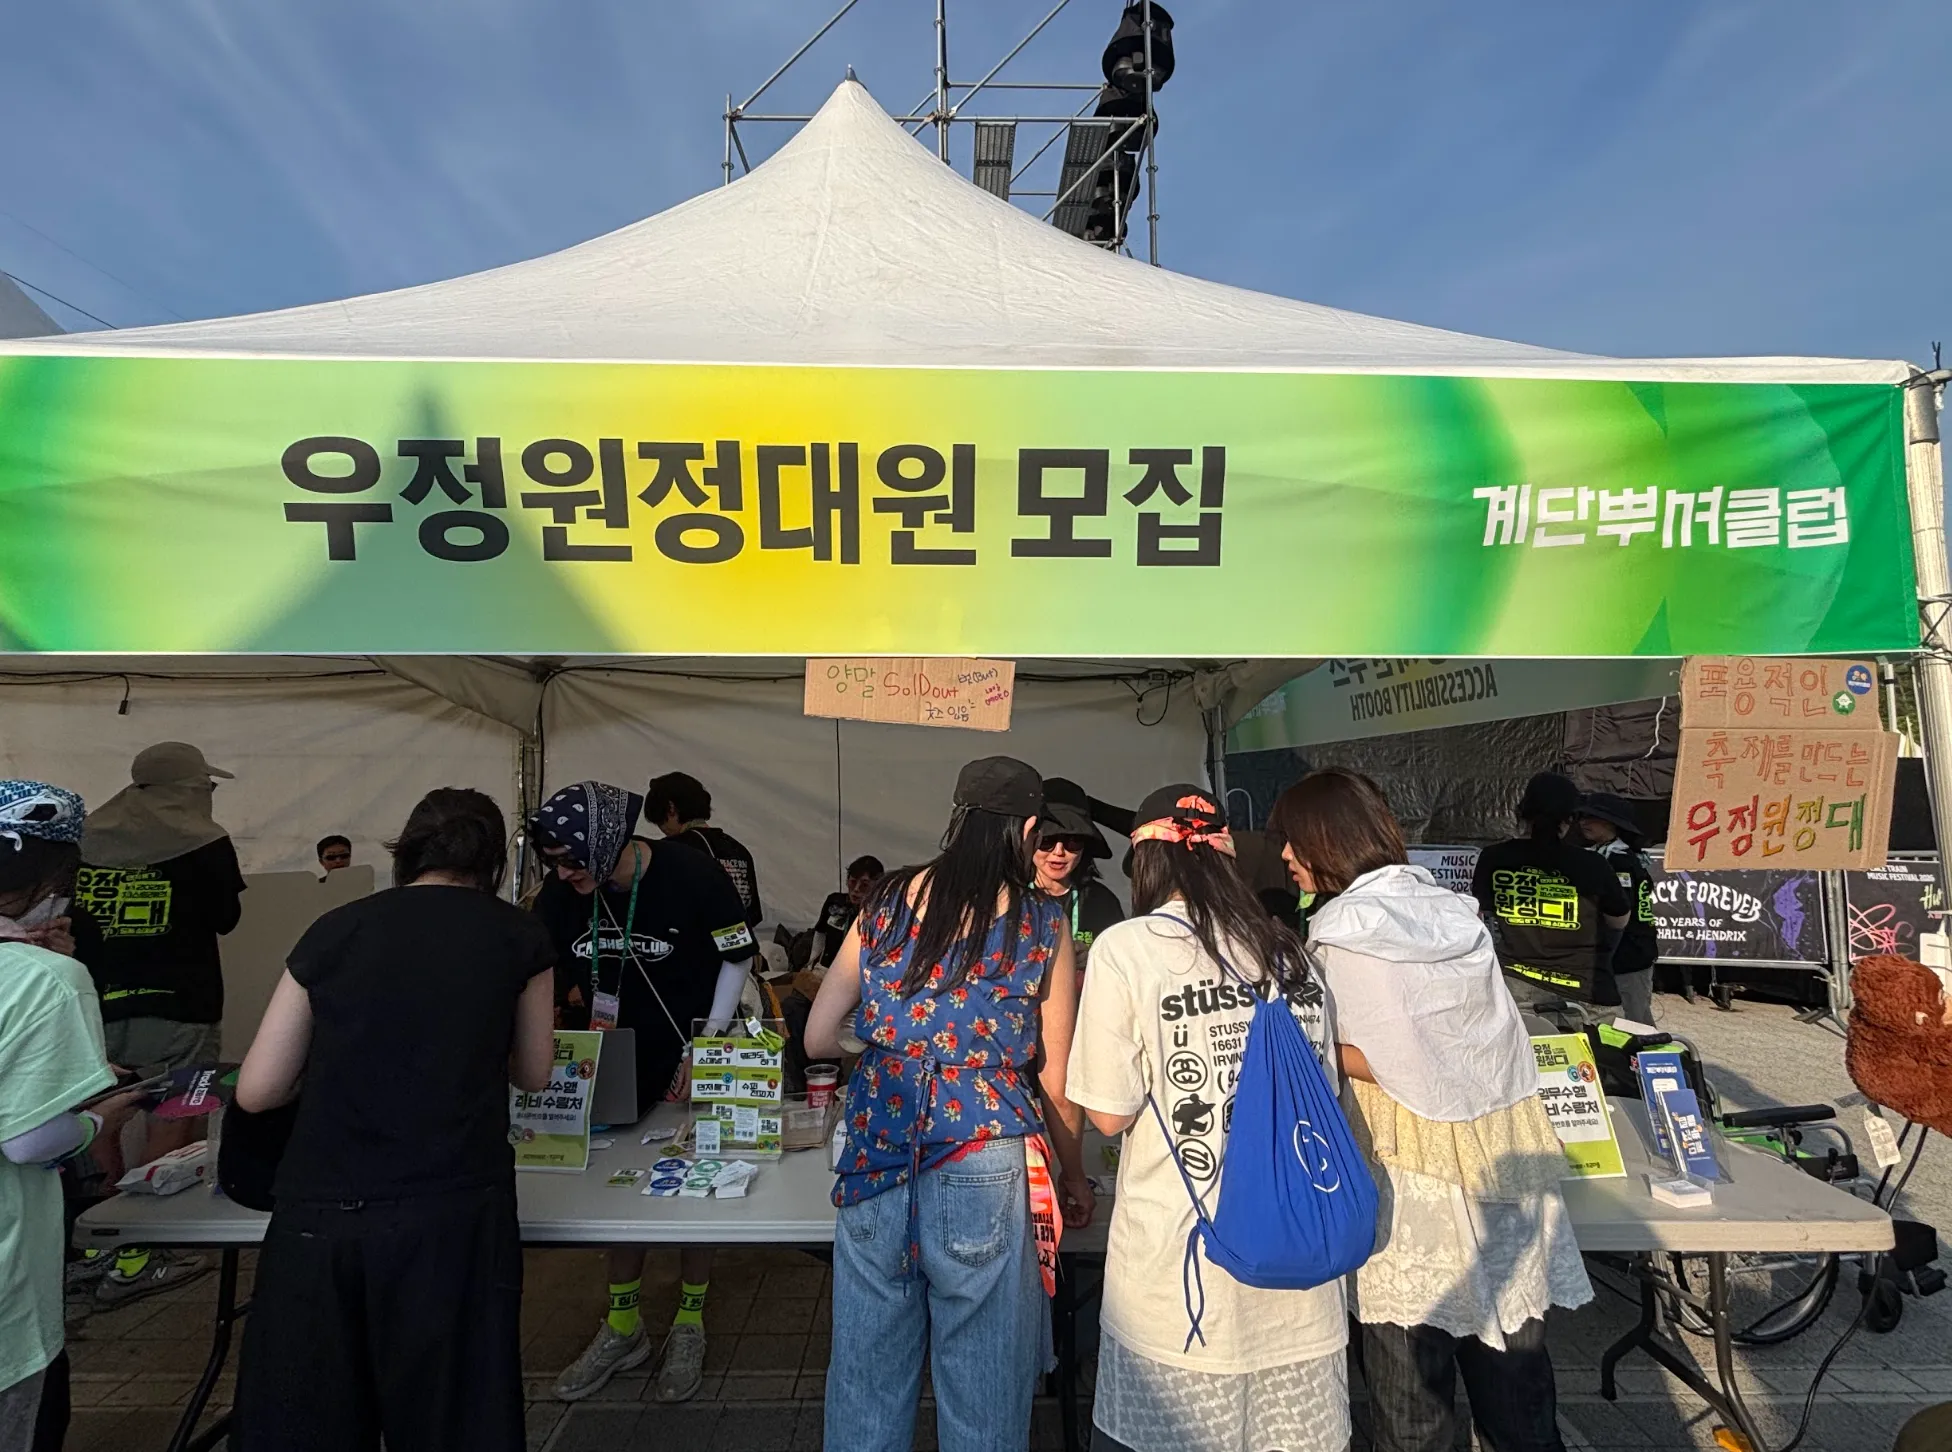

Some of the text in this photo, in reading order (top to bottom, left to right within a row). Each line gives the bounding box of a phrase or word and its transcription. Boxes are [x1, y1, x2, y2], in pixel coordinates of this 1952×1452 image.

[281, 435, 1227, 567] 우정원정대원 모집
[1472, 484, 1849, 549] 계단뿌셔클럽
[827, 665, 876, 698] 양말
[1699, 658, 1828, 717] 포용적인
[1702, 731, 1869, 789] 축제를 만드는
[1687, 793, 1867, 862] 우정원정대
[1441, 855, 1476, 867] MUSIC
[1427, 868, 1474, 880] ESTIVAL
[1867, 872, 1888, 881] MUSIC
[1888, 873, 1919, 882] FESTIVAL
[1451, 881, 1474, 892] 202
[1494, 872, 1537, 896] 우정
[1686, 880, 1763, 923] FOREVER
[1669, 917, 1706, 928] YEARS
[1708, 918, 1724, 928] OF
[1685, 931, 1695, 939] &
[1695, 930, 1748, 942] HENDRIX
[1173, 1023, 1188, 1048] ü
[1211, 1037, 1242, 1052] 16631
[1533, 1043, 1552, 1056] 우정
[1535, 1053, 1570, 1067] 원정대
[1561, 1100, 1600, 1116] 수령처
